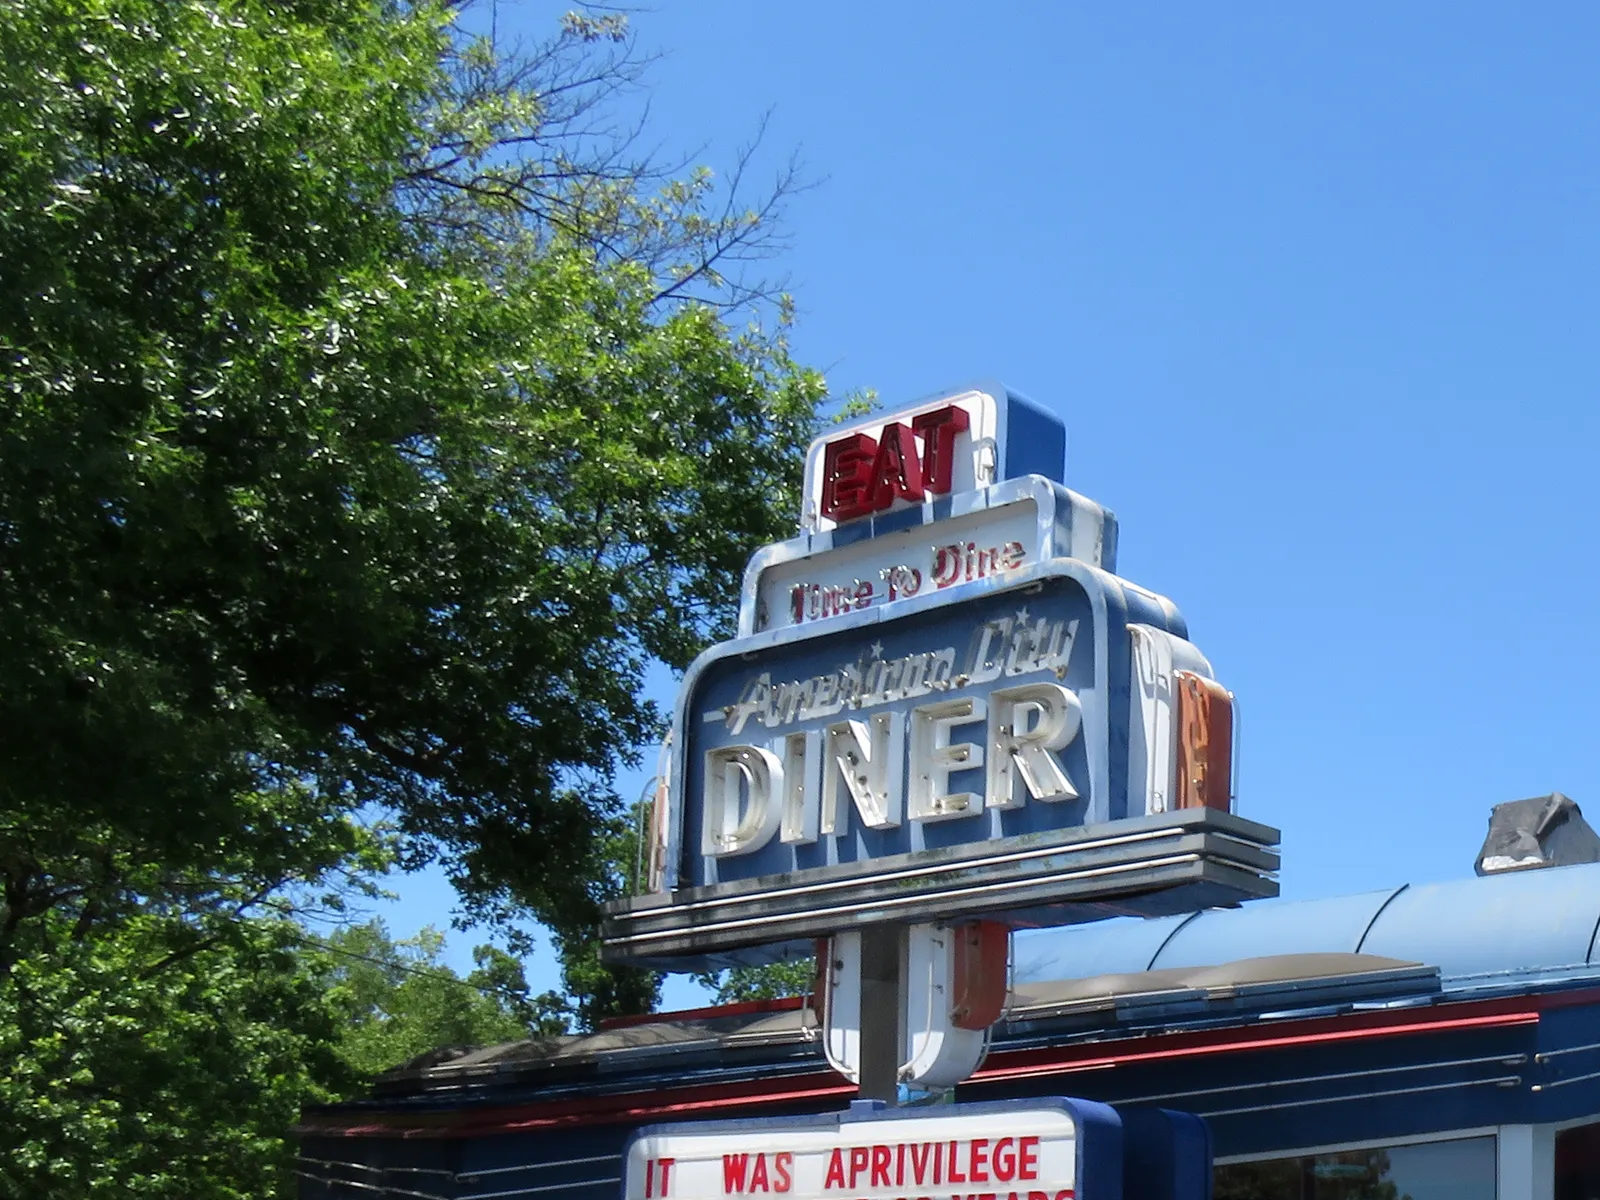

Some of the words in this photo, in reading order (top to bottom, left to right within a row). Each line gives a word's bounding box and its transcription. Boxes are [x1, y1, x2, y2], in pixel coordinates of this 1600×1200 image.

[821, 404, 970, 522] EAT
[788, 578, 874, 625] Time
[879, 562, 924, 600] To
[930, 537, 1024, 590] Dine
[703, 642, 958, 736] American
[964, 616, 1080, 688] City
[702, 682, 1080, 858] DINER
[645, 1158, 676, 1198] IT
[722, 1151, 793, 1194] WAS
